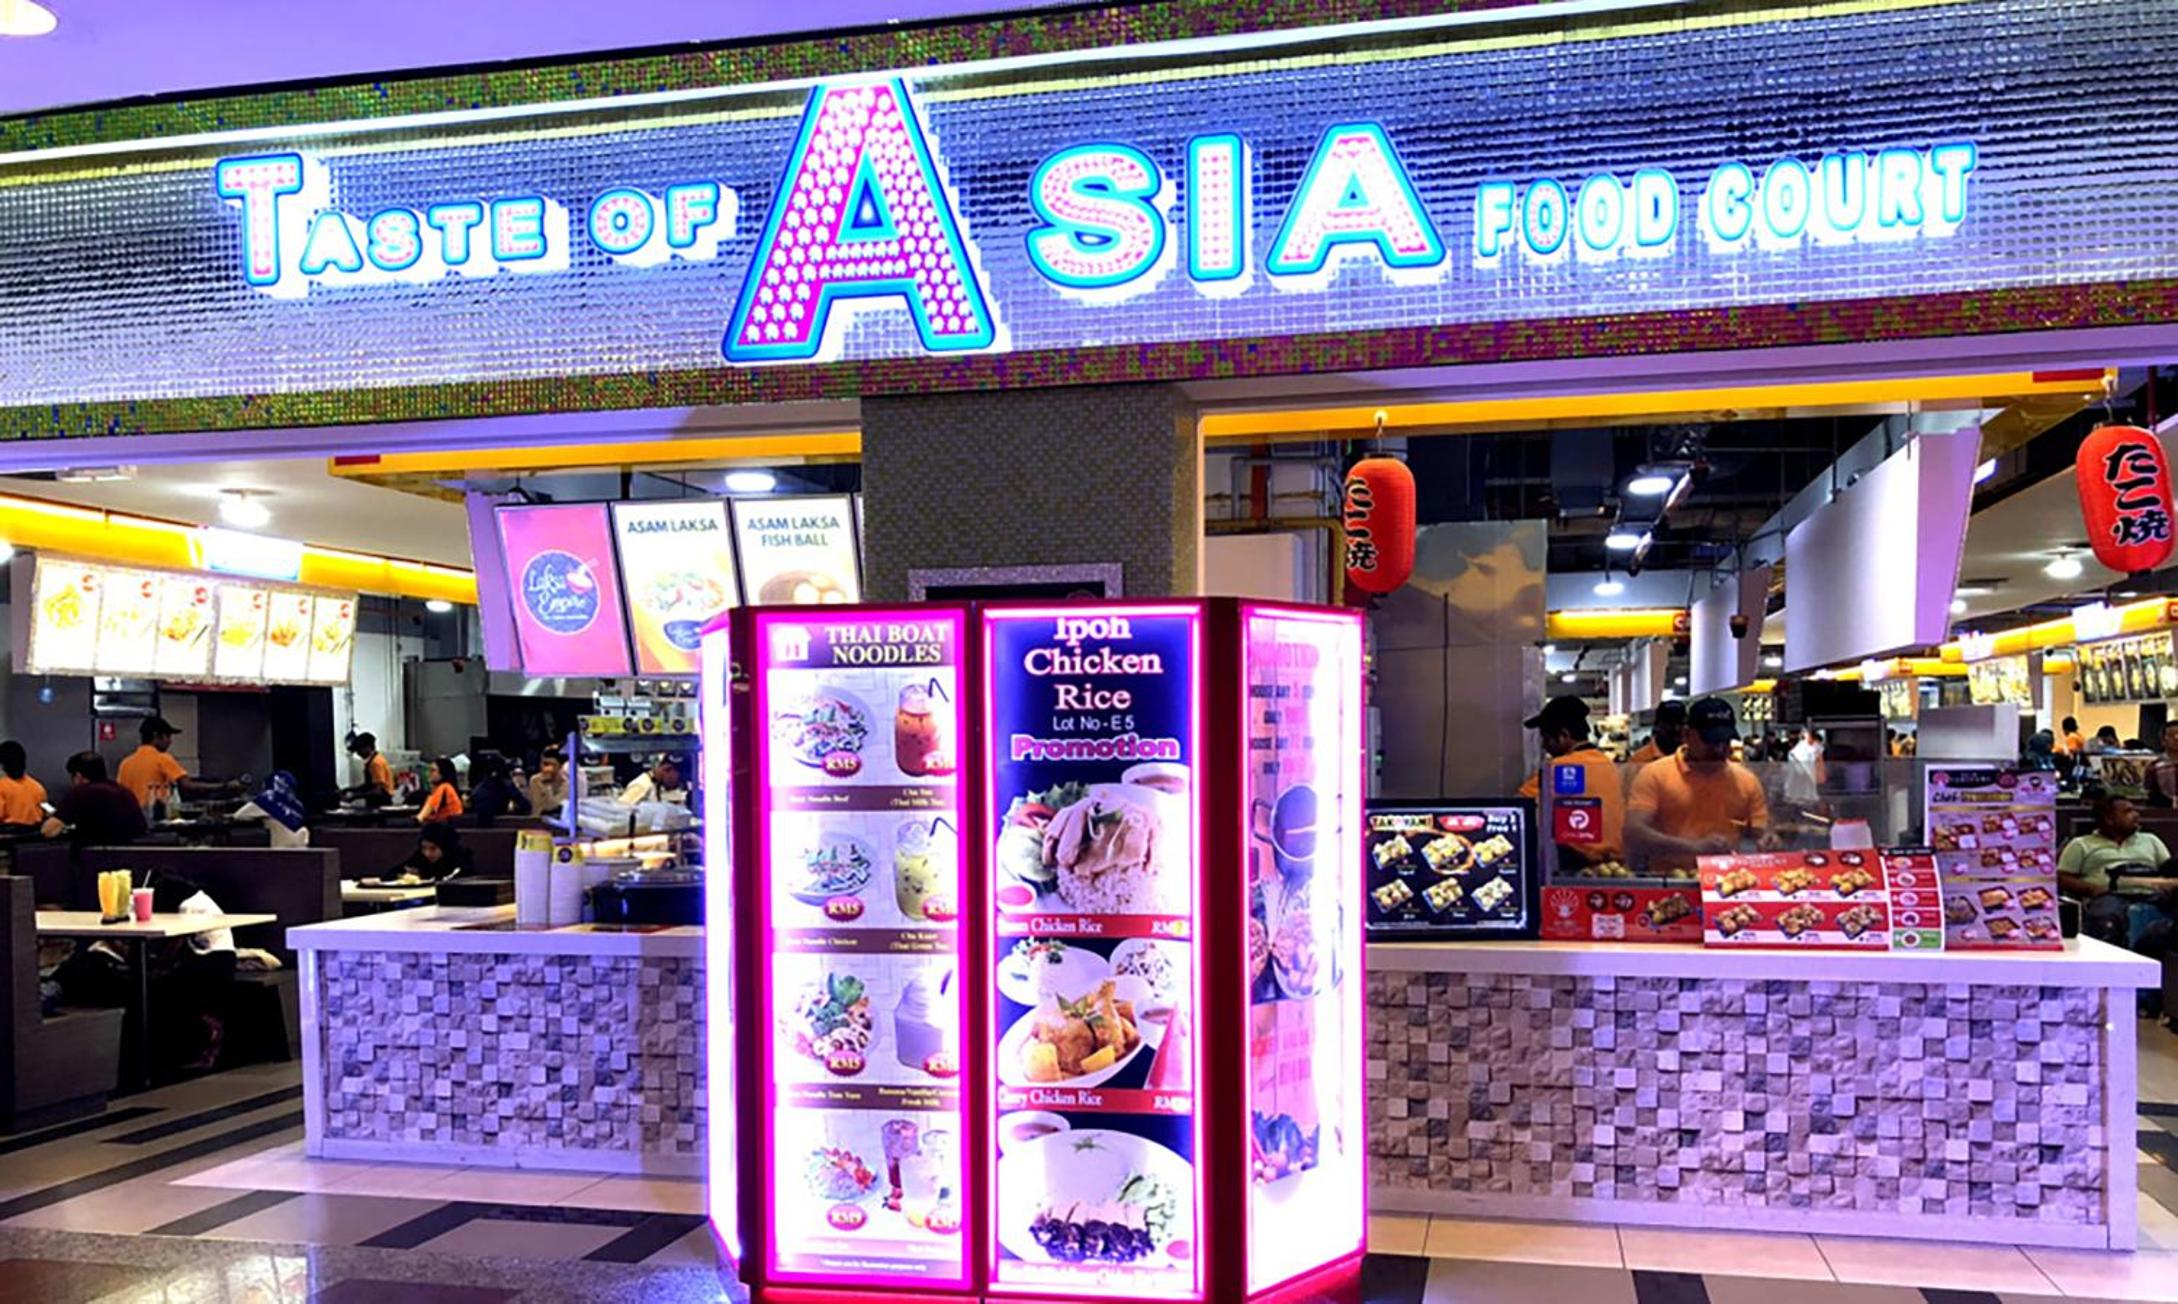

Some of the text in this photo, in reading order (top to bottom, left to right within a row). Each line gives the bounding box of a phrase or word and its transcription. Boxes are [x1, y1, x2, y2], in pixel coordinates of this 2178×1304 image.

[588, 180, 721, 254] OF
[722, 76, 1447, 363] ASIA
[1475, 167, 1679, 259] FOOD
[1706, 142, 1977, 242] COURT
[2103, 442, 2170, 547] たこ焼
[627, 518, 719, 534] ASAM LAKSA
[747, 515, 840, 531] ASAM LAKSA
[761, 532, 829, 547] FISH BALL
[825, 624, 948, 644] THAI BOAT
[1053, 616, 1132, 646] Ipoh
[832, 644, 943, 665] NOODLES
[1024, 647, 1164, 676] Chicken
[1053, 683, 1132, 710] Rice
[1053, 715, 1075, 731] Lot
[1011, 731, 1180, 761] Promotion
[1030, 917, 1076, 933] Chicken
[1078, 918, 1104, 933] Rice
[1030, 1089, 1076, 1106] Chicken
[1078, 1090, 1104, 1106] Rice
